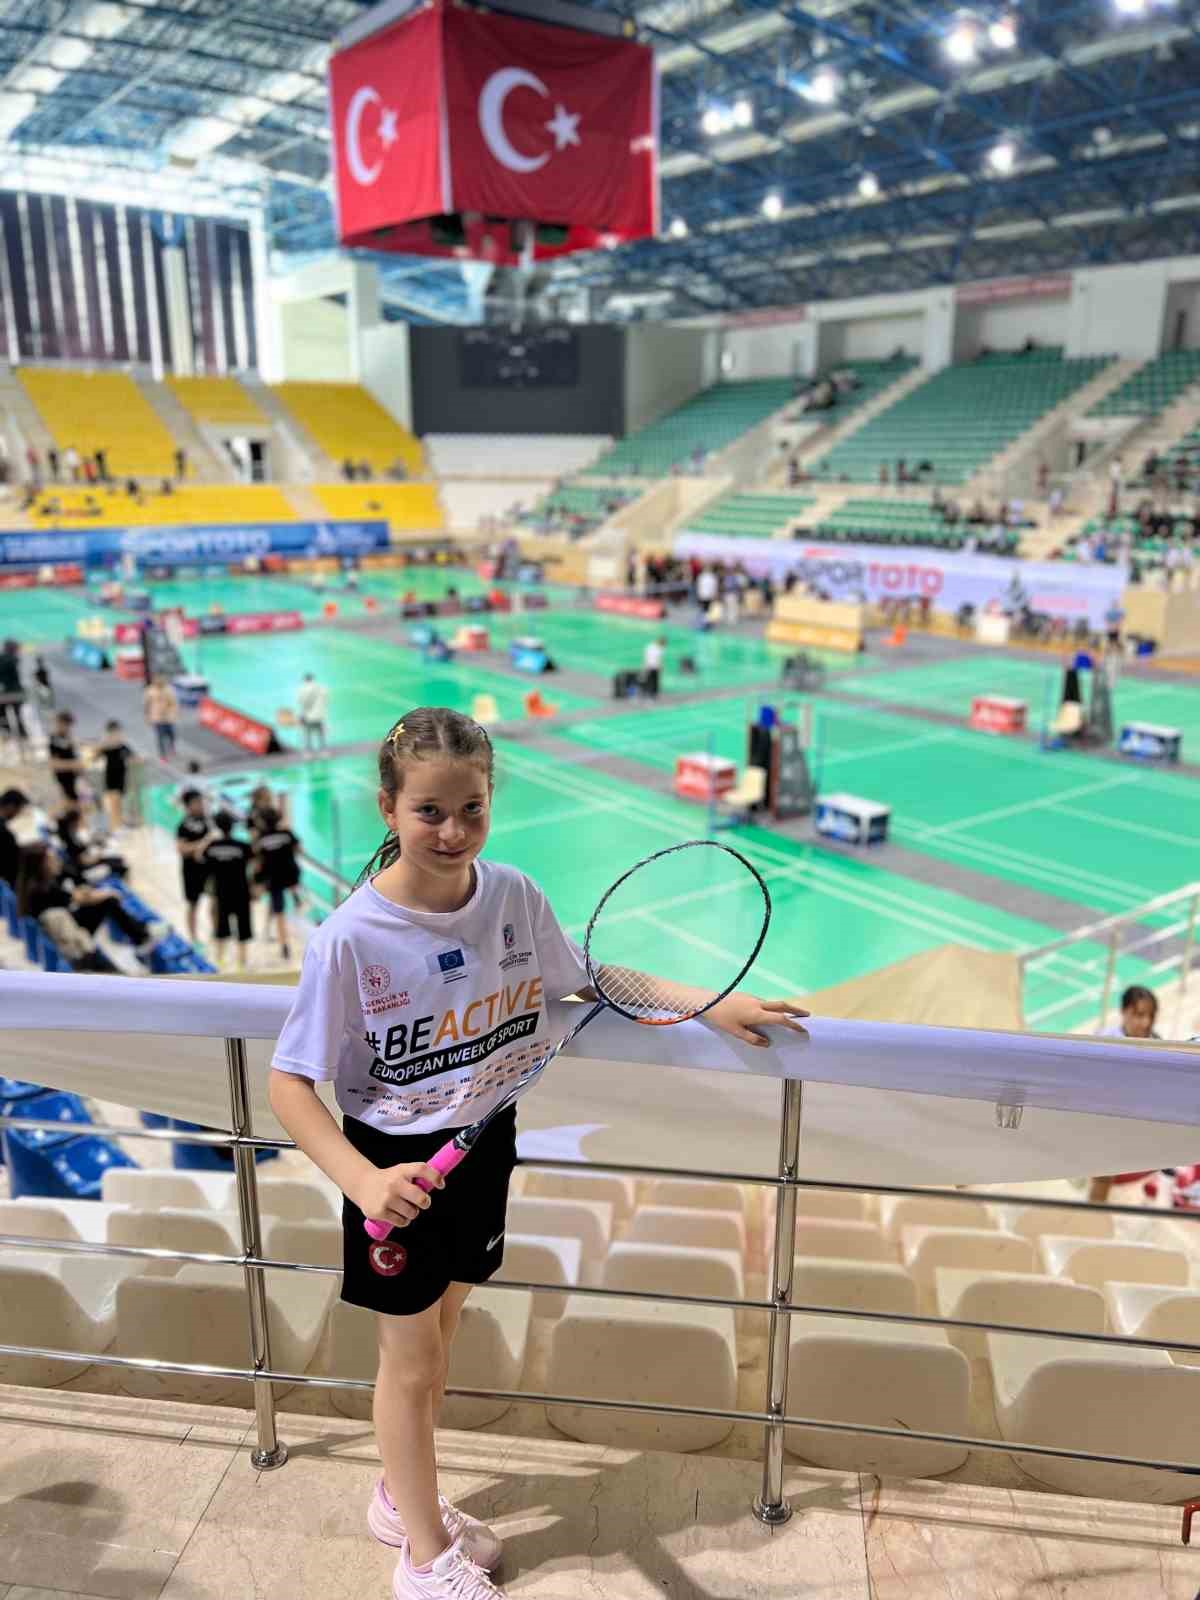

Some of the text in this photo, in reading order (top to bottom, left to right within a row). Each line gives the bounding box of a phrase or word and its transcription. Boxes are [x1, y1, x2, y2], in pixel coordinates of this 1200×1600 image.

[364, 976, 543, 1061] #BEACTIVE
[373, 1056, 444, 1082] EUROPEAN
[448, 1043, 485, 1065] WEEK
[486, 1034, 499, 1051] OF
[498, 1018, 535, 1044] SPORT
